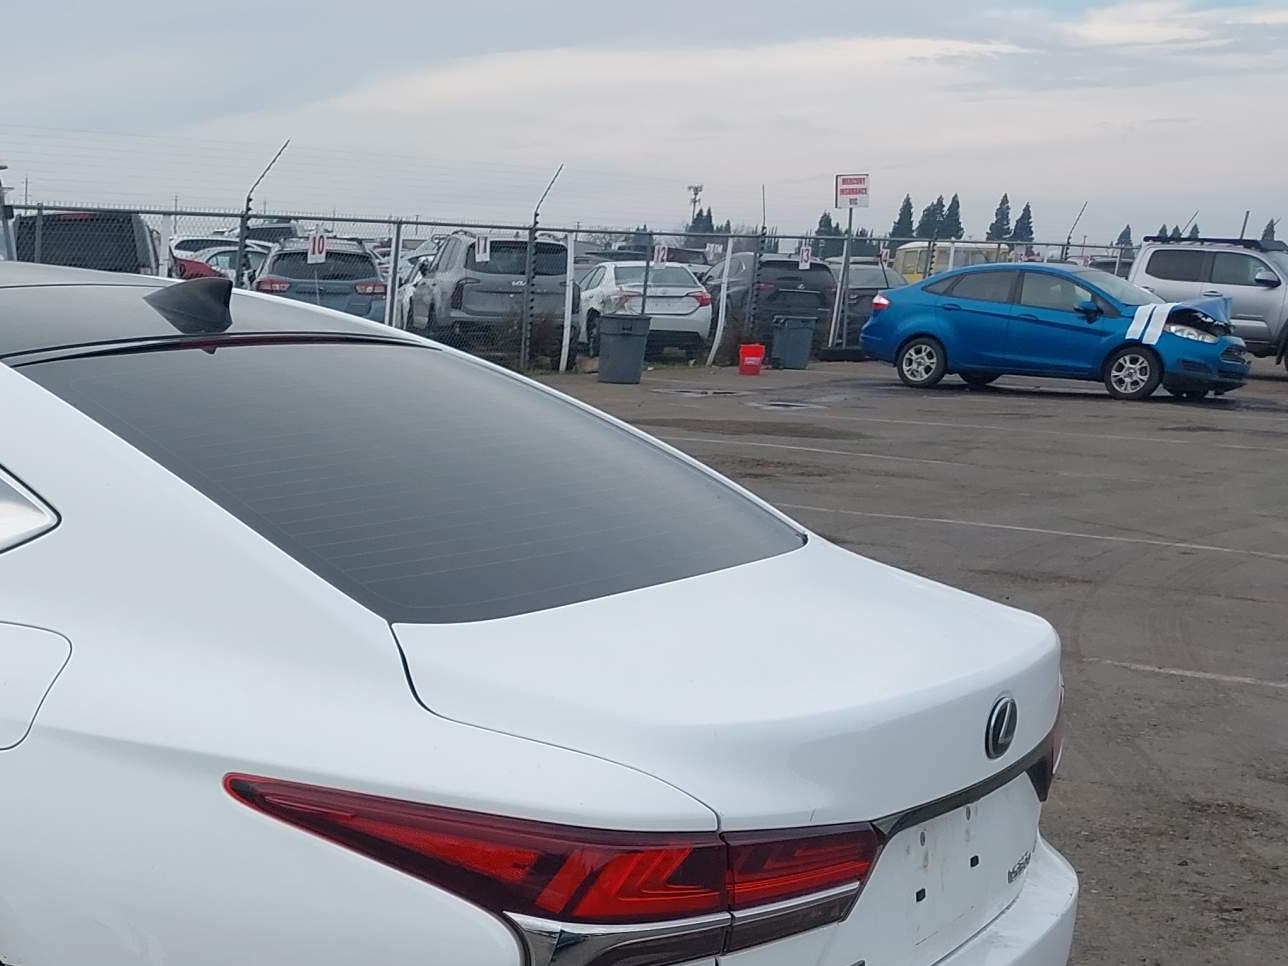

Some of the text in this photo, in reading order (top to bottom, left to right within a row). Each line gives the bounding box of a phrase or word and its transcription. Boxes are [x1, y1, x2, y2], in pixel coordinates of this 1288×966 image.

[311, 234, 325, 255] 10
[656, 246, 667, 263] 12
[801, 248, 811, 263] 13
